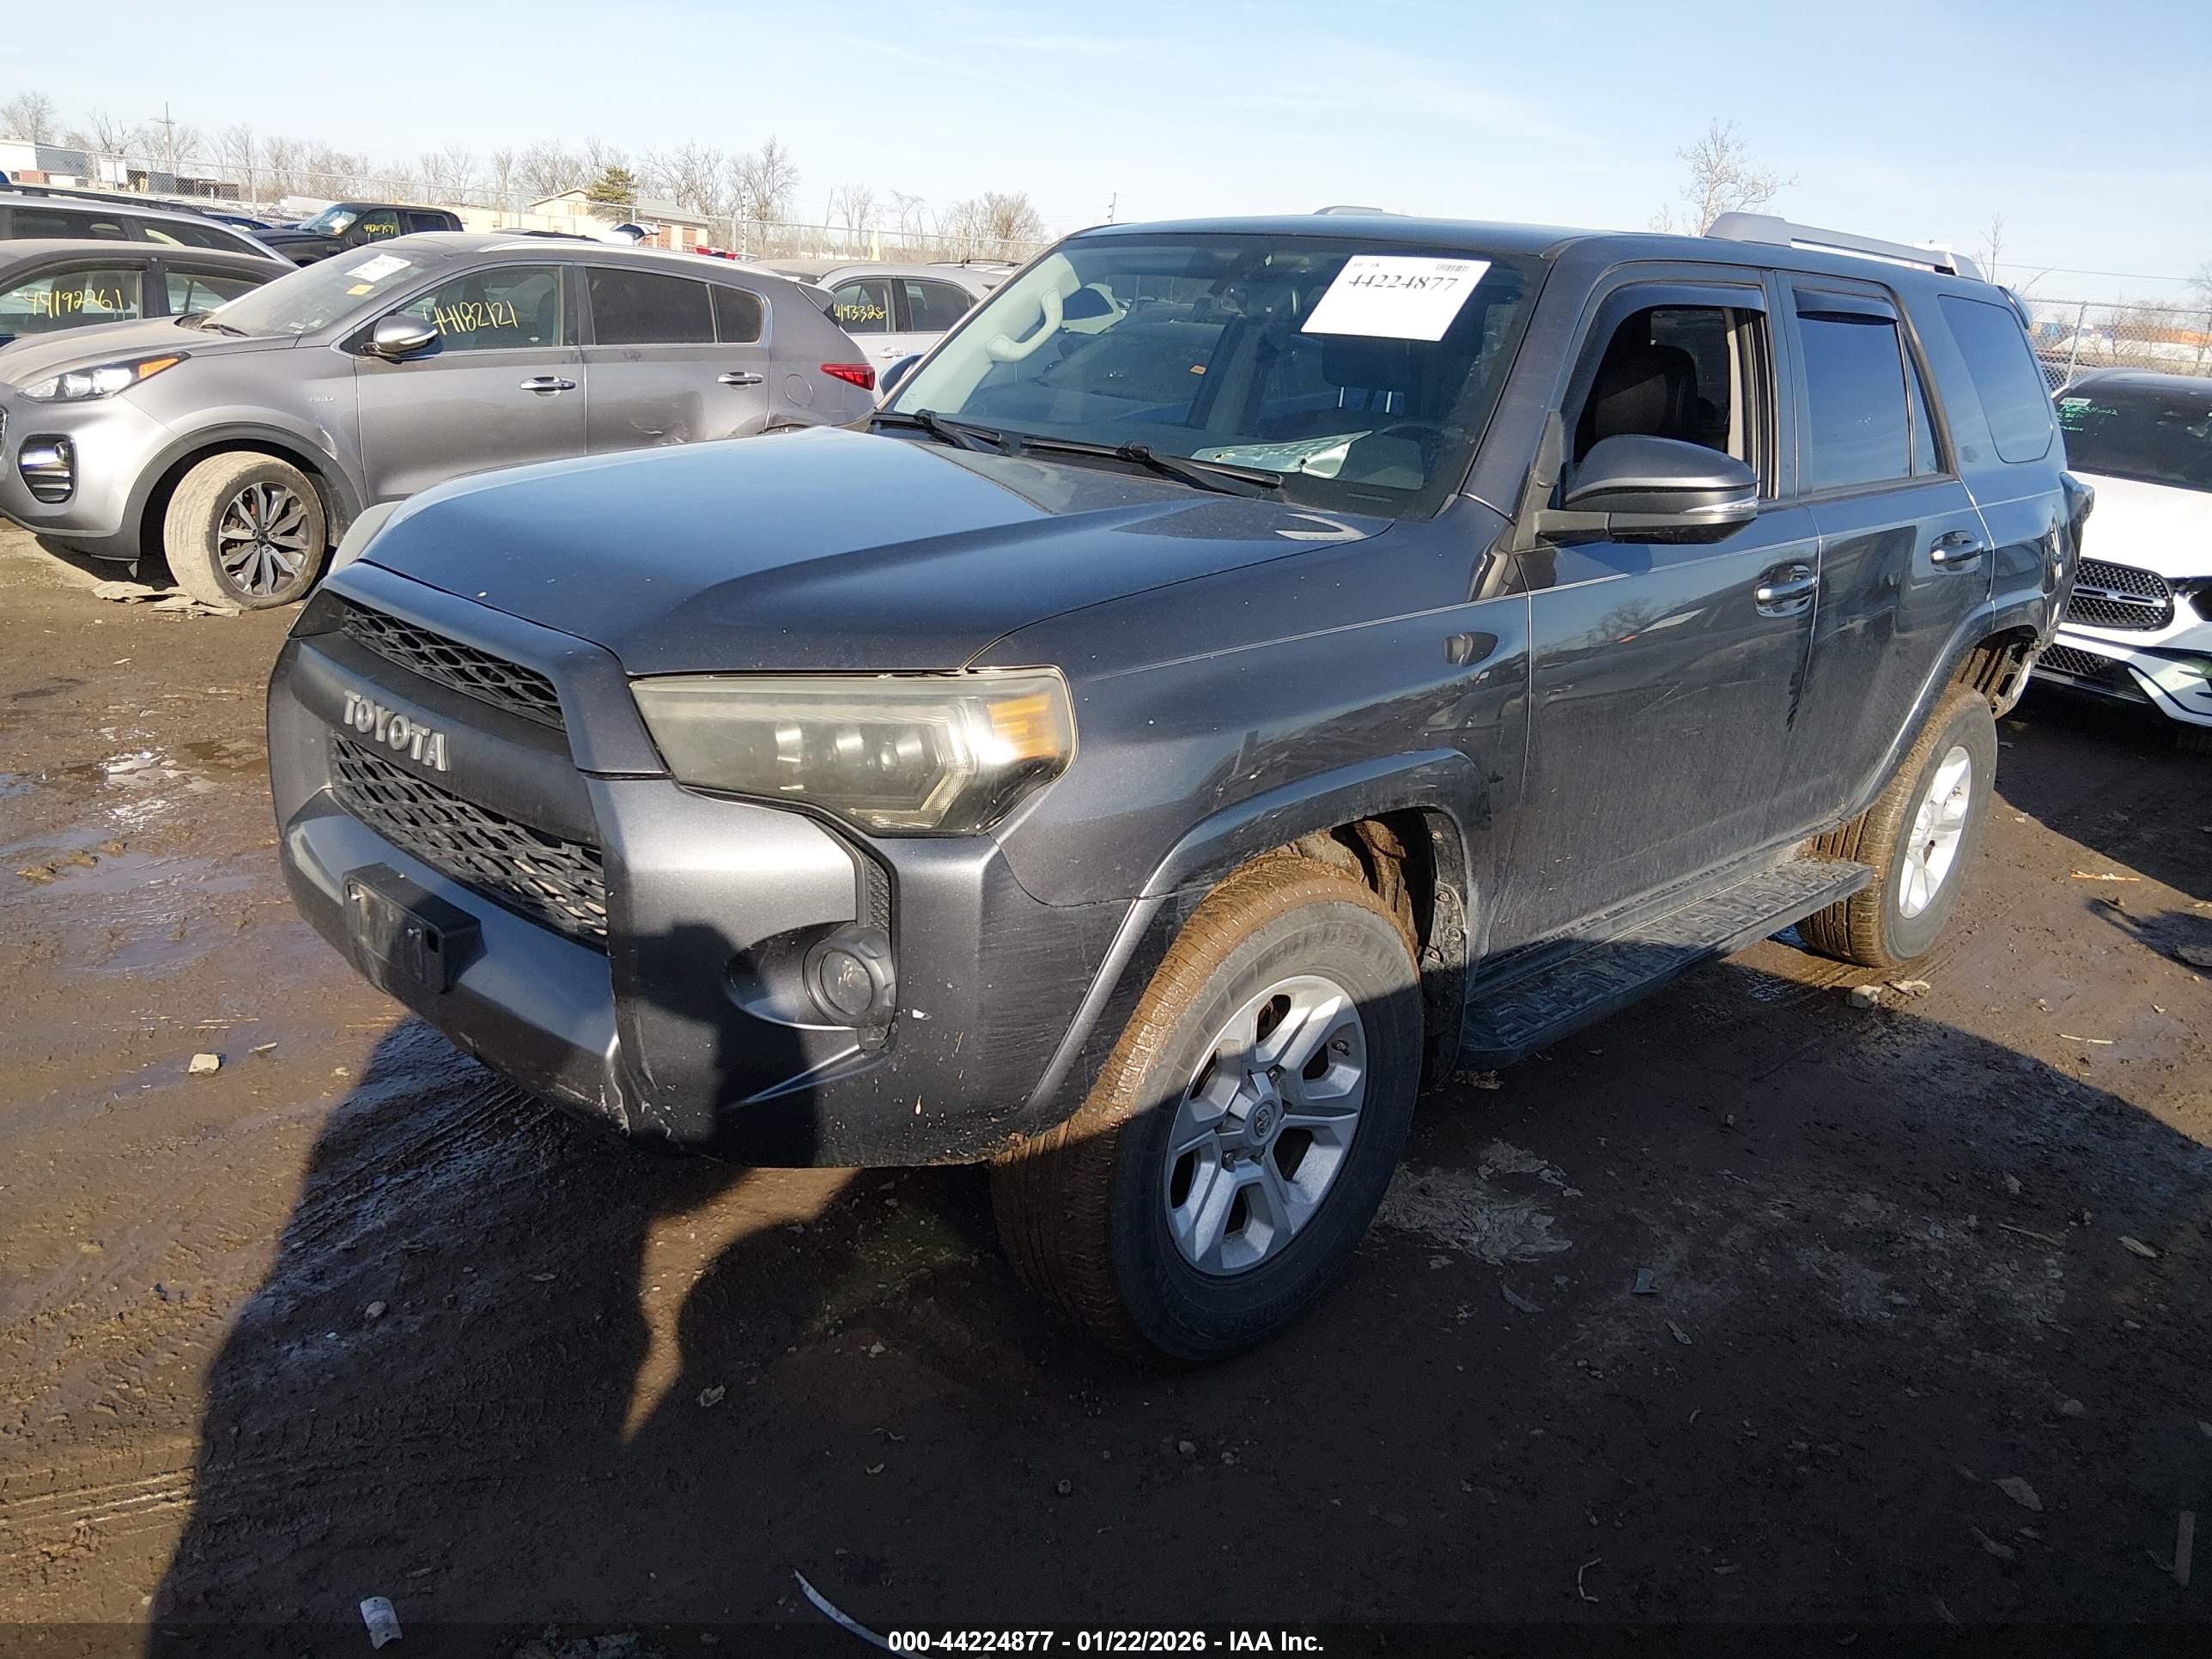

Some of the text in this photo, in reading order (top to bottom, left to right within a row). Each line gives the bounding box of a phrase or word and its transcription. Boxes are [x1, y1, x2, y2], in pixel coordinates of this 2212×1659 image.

[1348, 274, 1459, 291] 44224877
[24, 289, 124, 319] 44192261
[343, 690, 447, 771] TOYOTA
